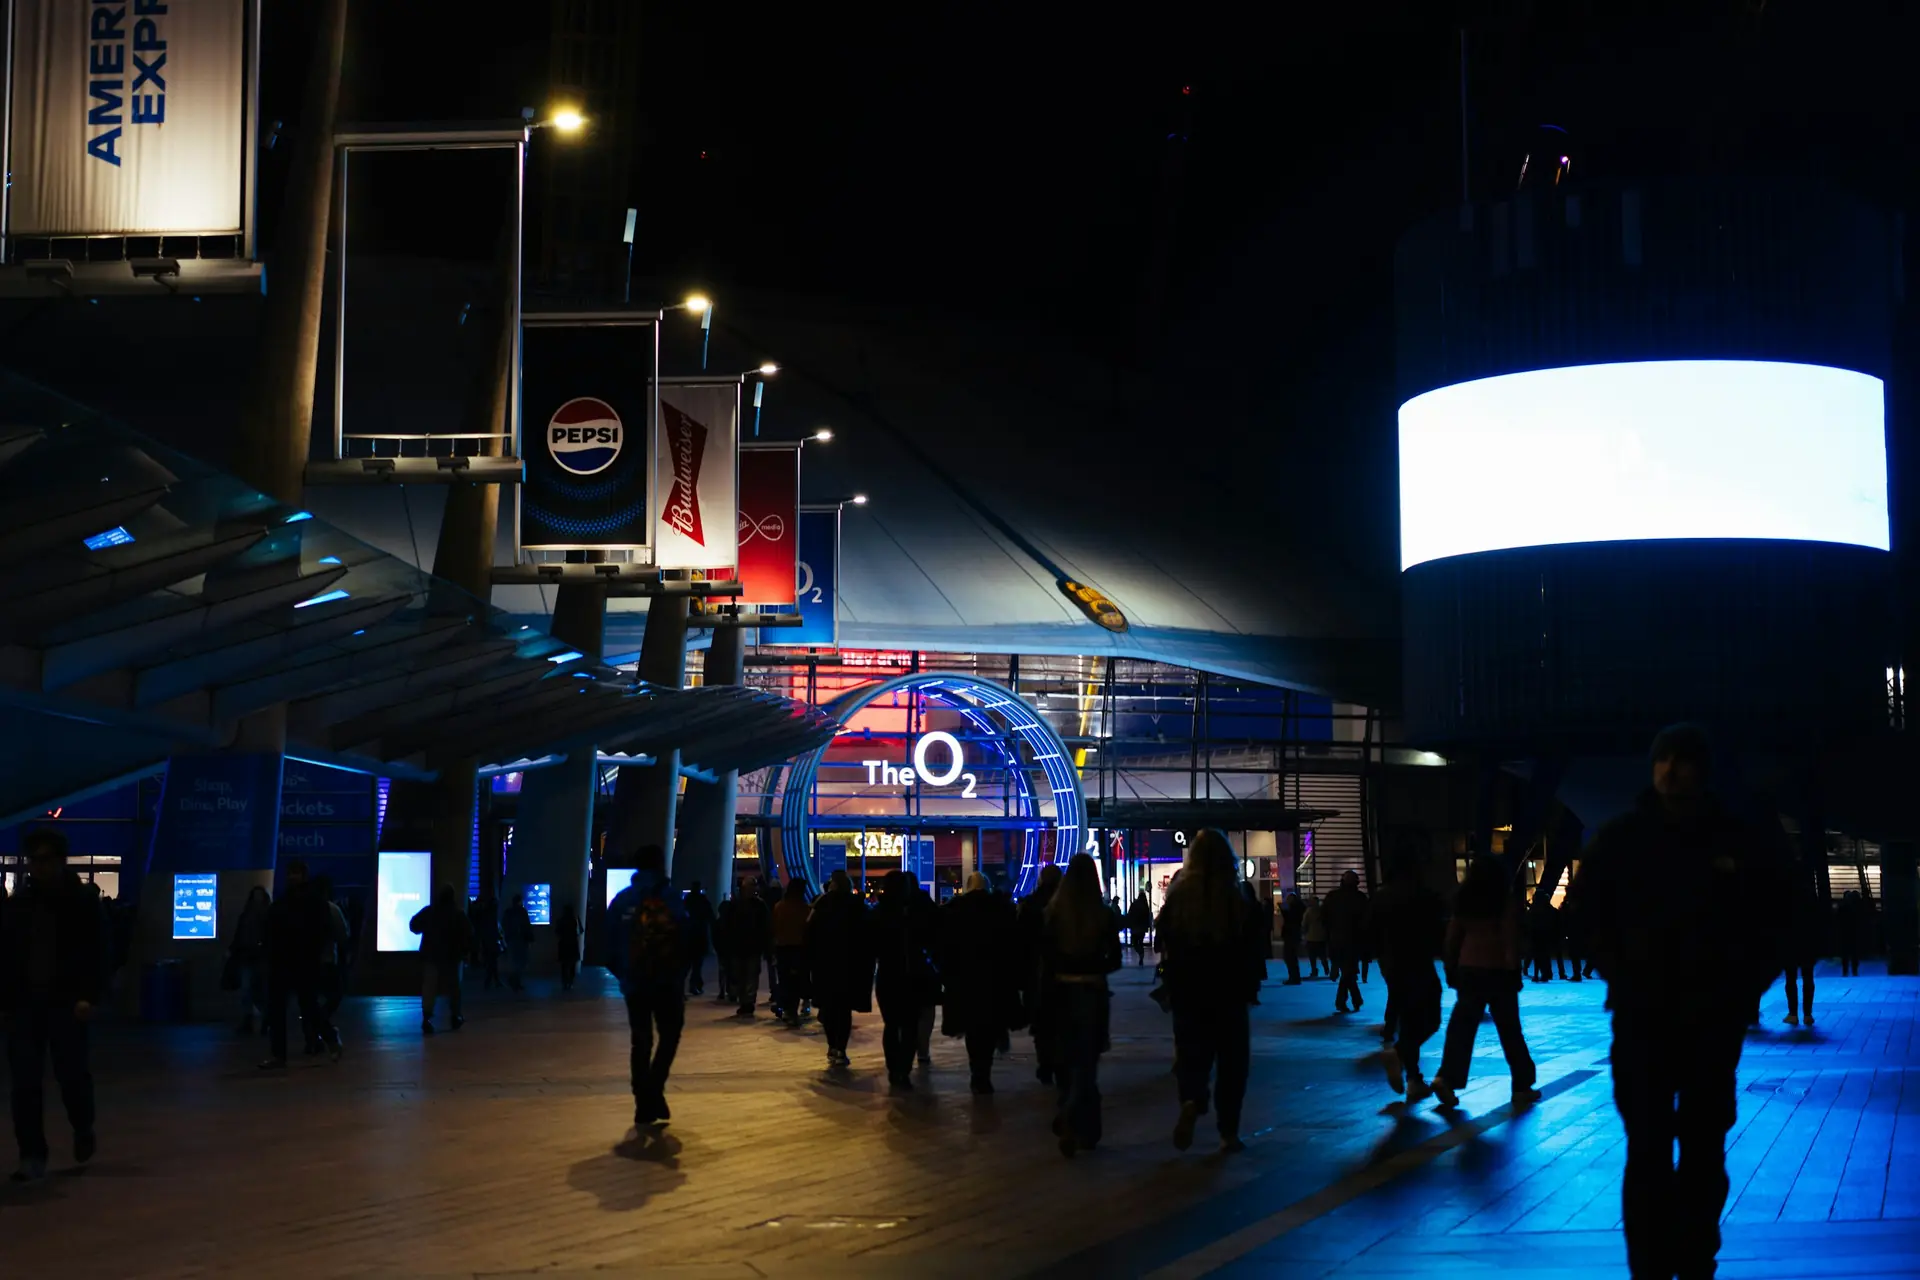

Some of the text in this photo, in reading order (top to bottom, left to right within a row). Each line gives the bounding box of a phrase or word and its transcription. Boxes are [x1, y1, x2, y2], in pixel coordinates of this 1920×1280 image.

[552, 427, 619, 444] PEPSI
[671, 413, 698, 537] Budweiser
[862, 731, 978, 799] The O2
[217, 797, 248, 813] Play
[279, 798, 336, 816] ickets
